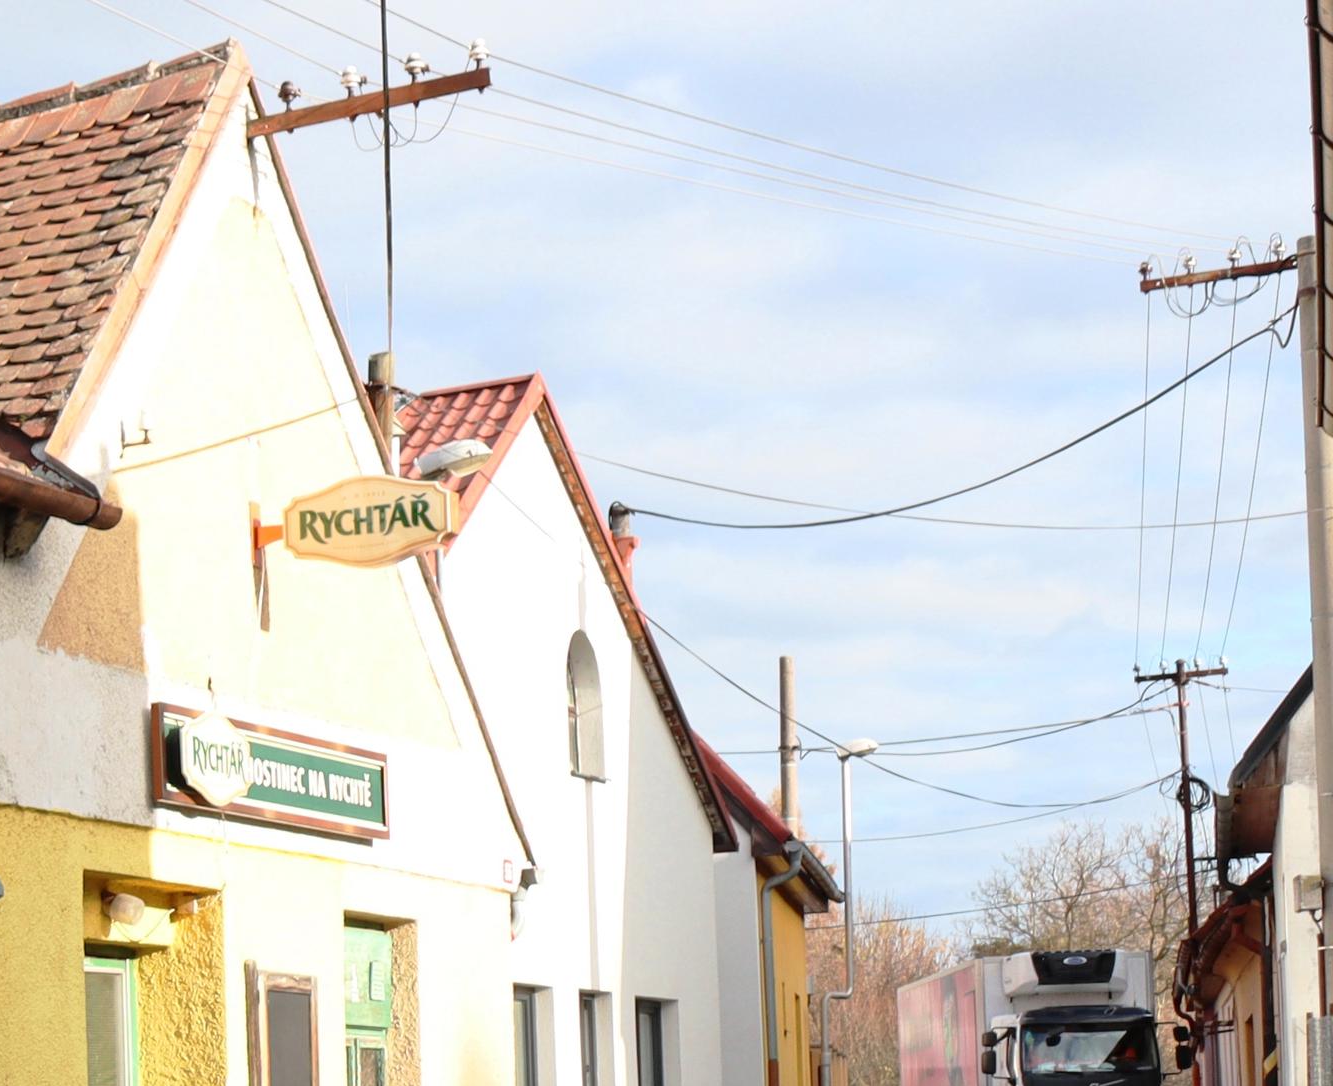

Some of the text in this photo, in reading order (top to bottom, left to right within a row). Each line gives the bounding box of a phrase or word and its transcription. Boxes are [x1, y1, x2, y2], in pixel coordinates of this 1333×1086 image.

[299, 493, 438, 545] RYCHTÁŘ
[193, 735, 248, 785] RYCHTÁŘ
[245, 756, 373, 808] HOSTINEC NA RYCHTĚ
